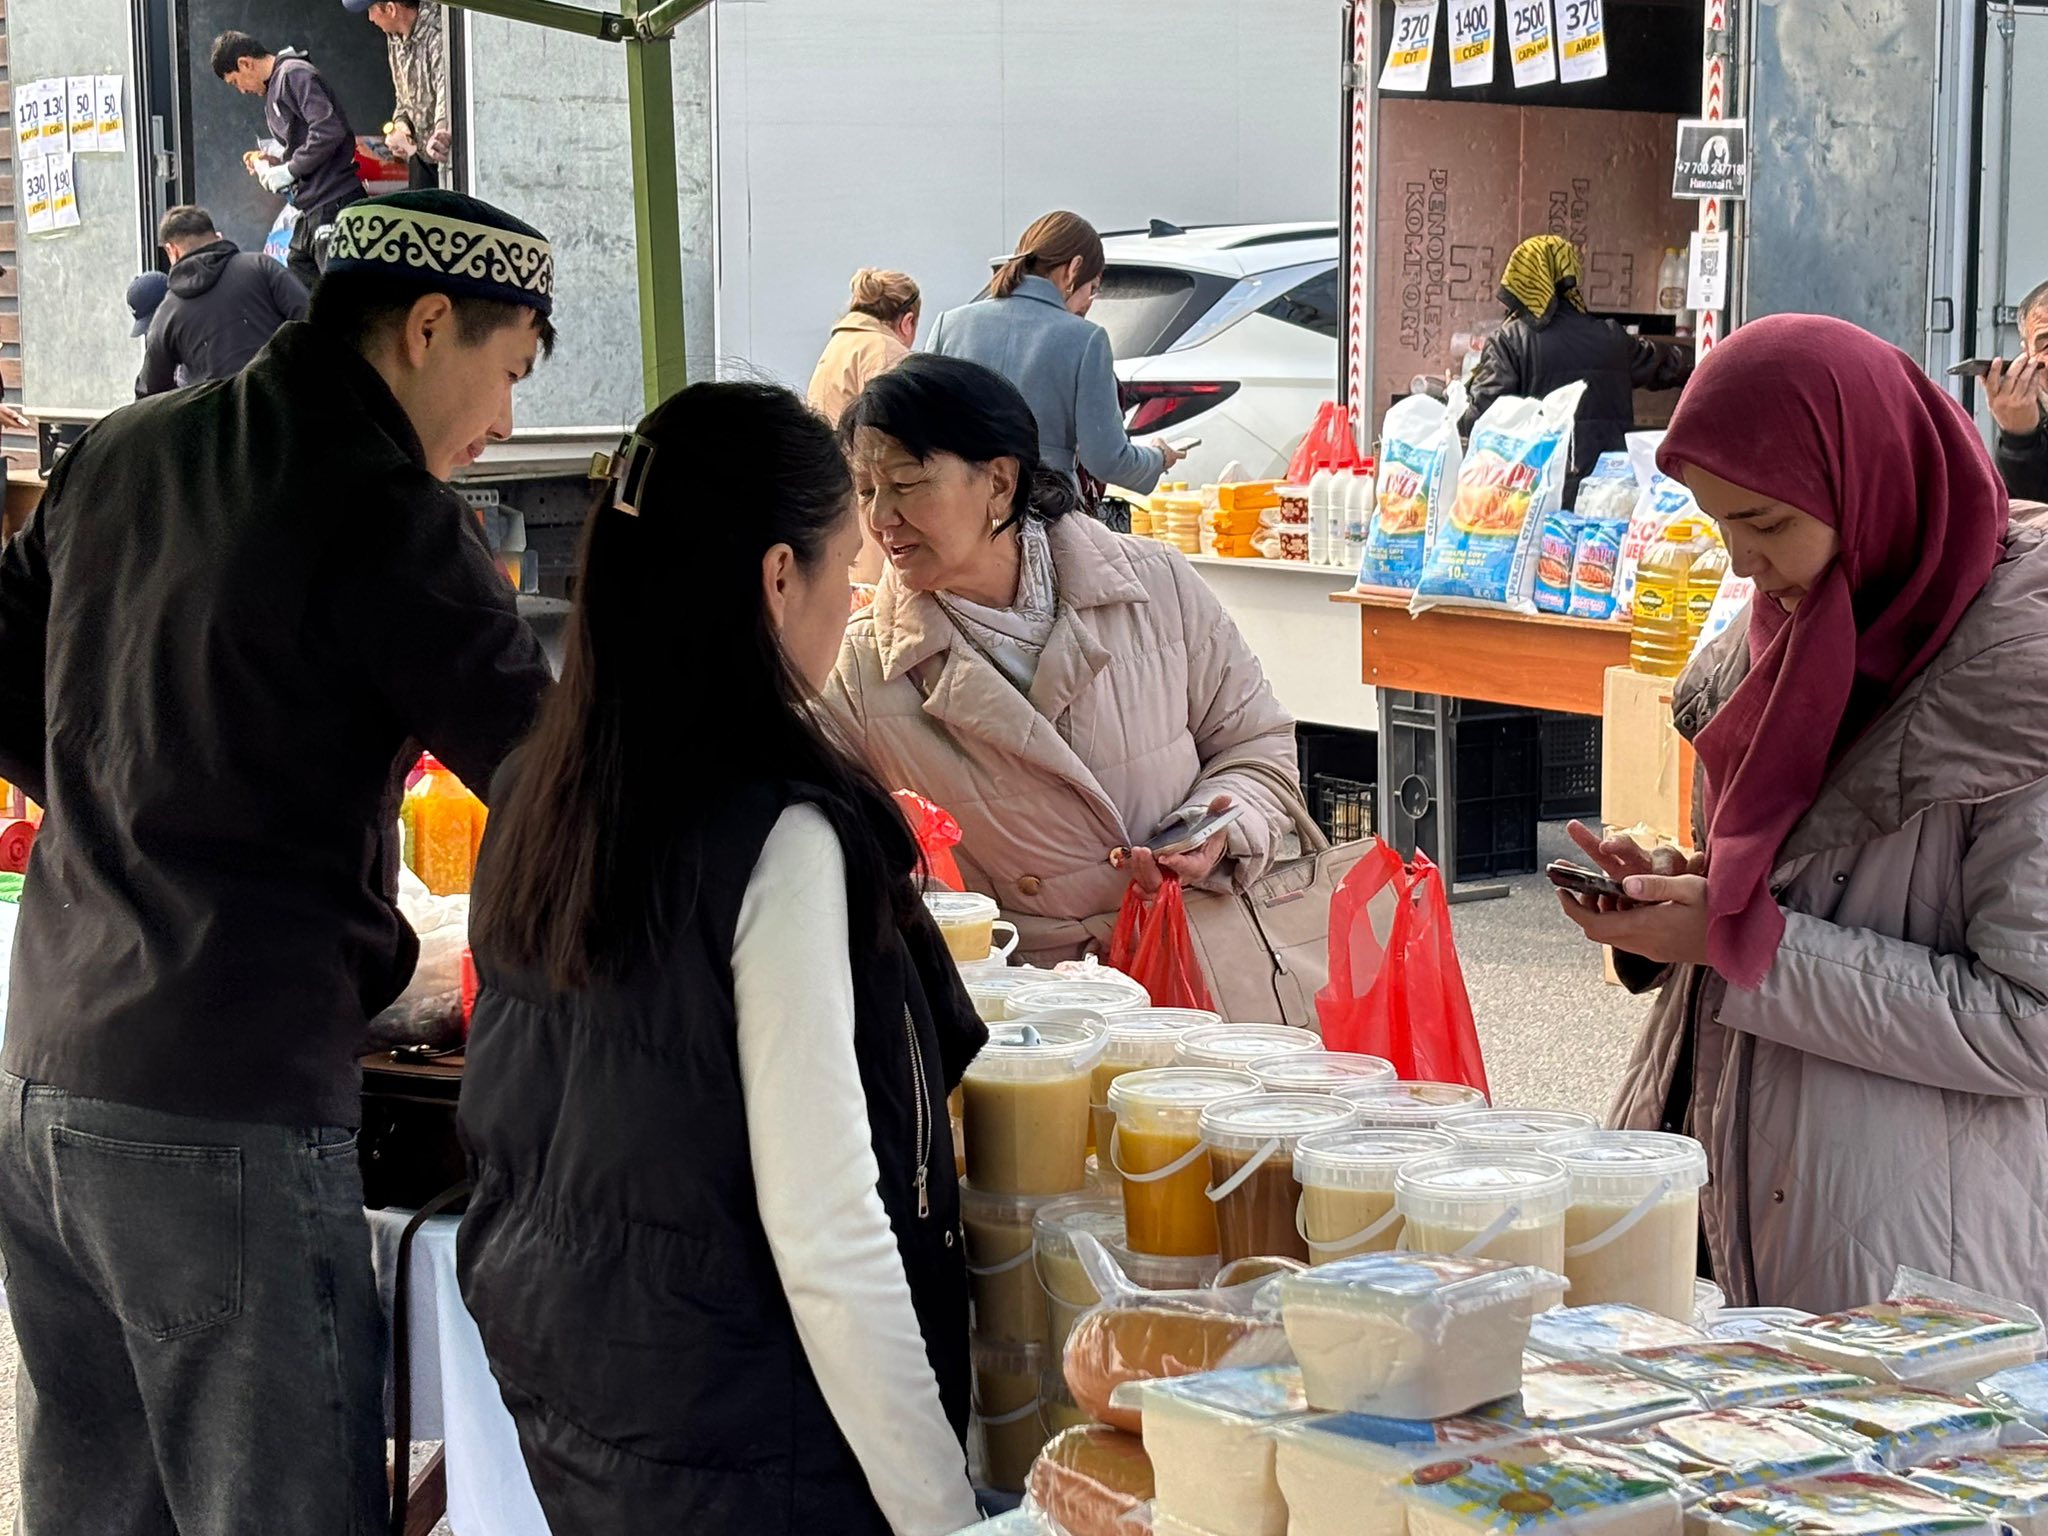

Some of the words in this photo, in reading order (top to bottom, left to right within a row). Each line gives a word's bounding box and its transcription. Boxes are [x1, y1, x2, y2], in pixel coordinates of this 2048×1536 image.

[1455, 5, 1488, 36] 1400
[1514, 1, 1544, 36] 2500
[1566, 0, 1599, 30] 370
[1399, 14, 1429, 42] 370
[20, 100, 38, 123] 170
[43, 95, 63, 117] 130
[77, 93, 89, 113] 50
[105, 94, 116, 114] 50
[27, 174, 46, 197] 330
[54, 169, 70, 192] 190
[1400, 182, 1425, 351] KOMFORT
[1422, 168, 1448, 358] PENOPLEX
